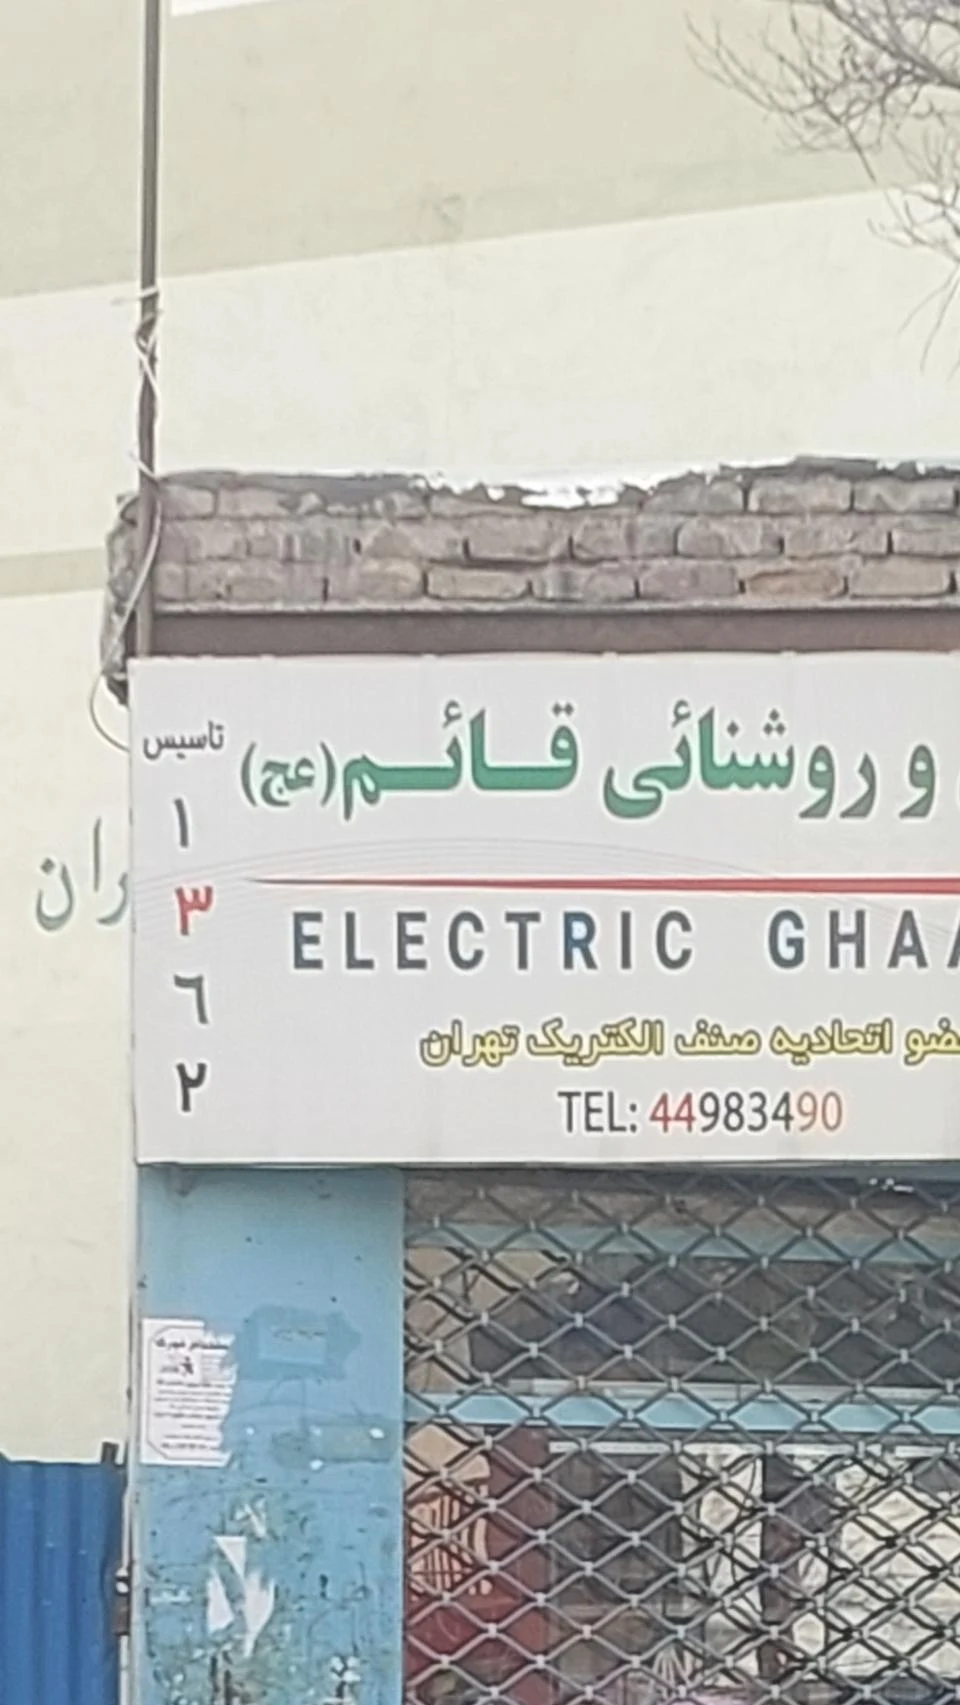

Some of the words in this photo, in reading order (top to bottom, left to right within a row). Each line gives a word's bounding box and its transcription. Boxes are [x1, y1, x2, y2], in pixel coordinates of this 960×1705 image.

[143, 720, 224, 760] تاسیس
[603, 699, 877, 819] روشنائی
[899, 744, 936, 819] و
[292, 909, 694, 971] ELECTRIC
[420, 1019, 520, 1067] تهران
[525, 1017, 664, 1066] الکتریک
[674, 1018, 762, 1057] صنف
[769, 1018, 894, 1066] اتحادیه
[557, 1091, 639, 1134] TEL:
[649, 1091, 843, 1133] 44983490
